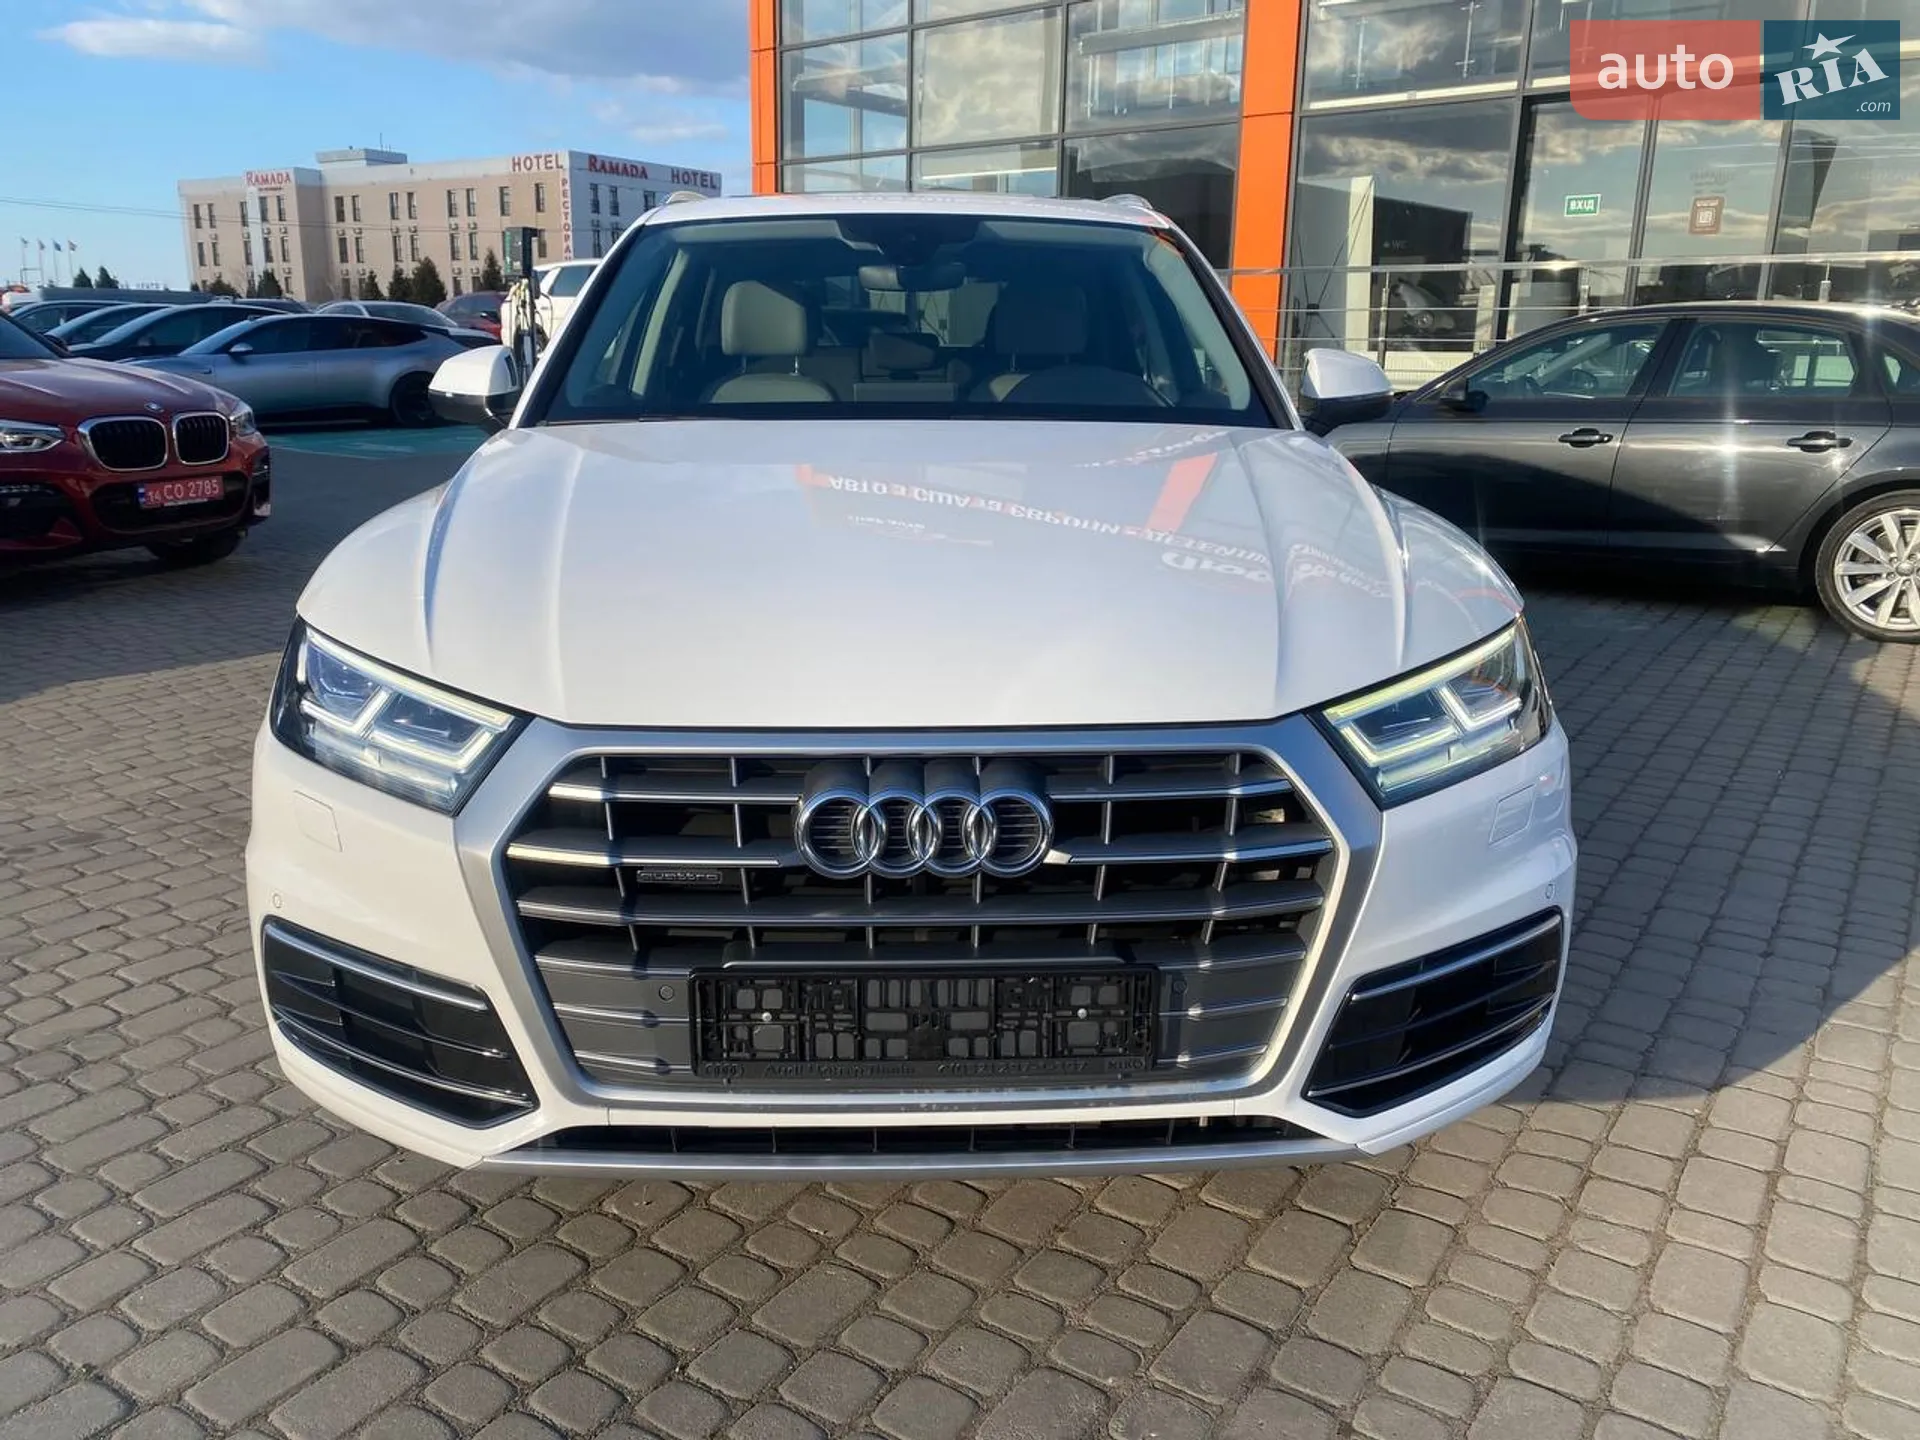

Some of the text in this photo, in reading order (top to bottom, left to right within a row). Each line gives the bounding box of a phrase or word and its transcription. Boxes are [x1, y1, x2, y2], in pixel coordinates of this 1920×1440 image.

[512, 153, 564, 172] HOTEL
[246, 171, 292, 186] RAMADA
[588, 155, 717, 190] RAMADA HOTEL
[188, 479, 220, 497] 2785
